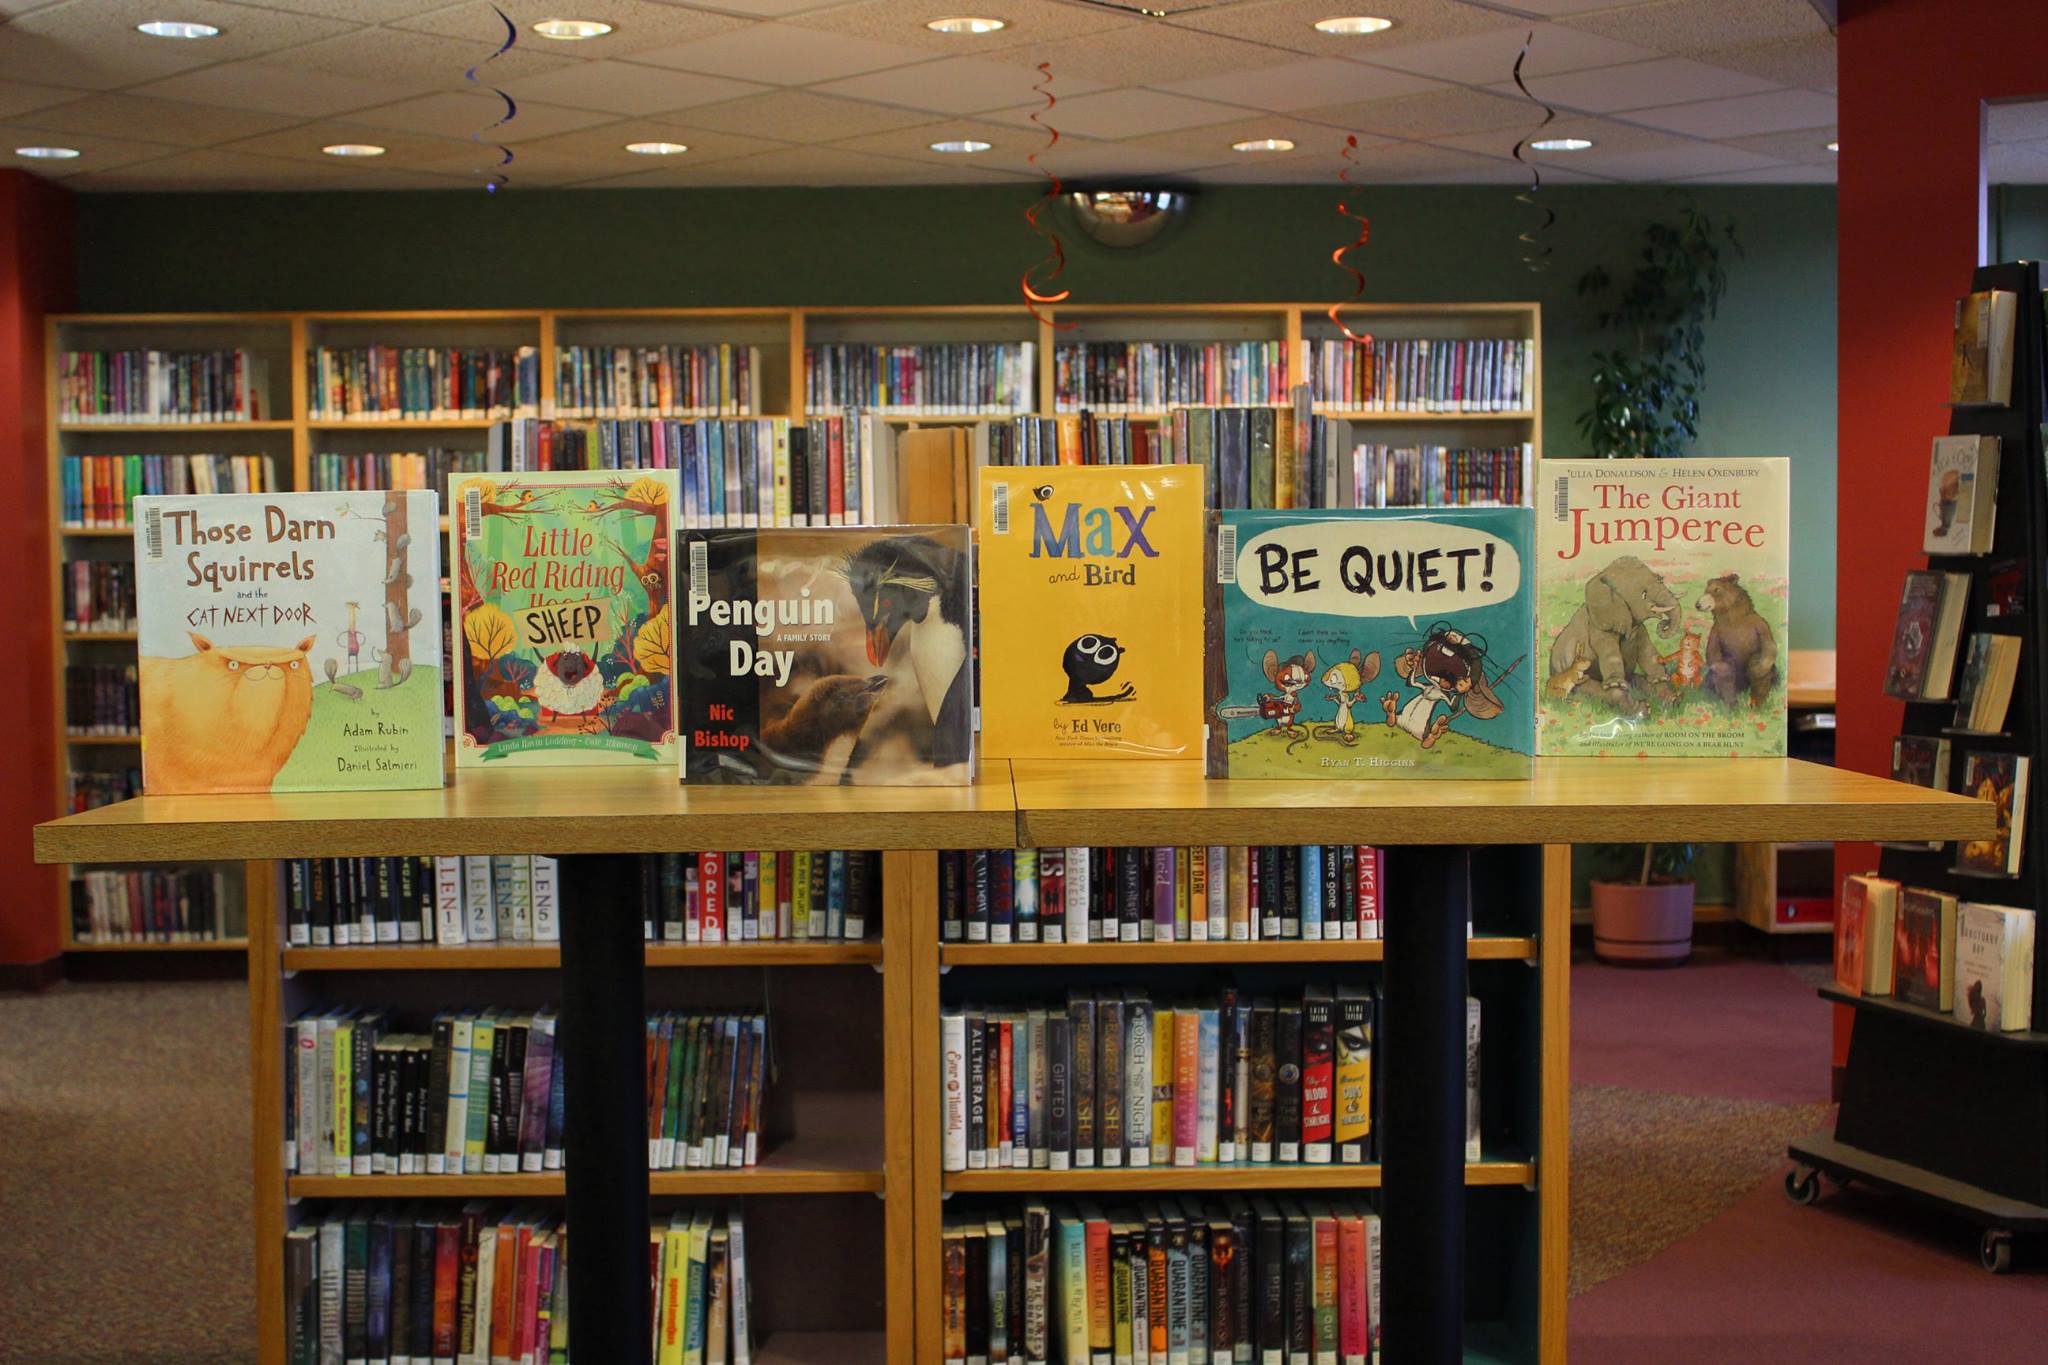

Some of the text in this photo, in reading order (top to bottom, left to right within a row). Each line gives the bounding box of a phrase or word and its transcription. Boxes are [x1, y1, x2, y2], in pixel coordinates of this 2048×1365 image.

[1568, 469, 1593, 479] ULIA
[1595, 469, 1656, 479] DONALDSON
[1672, 468, 1706, 478] HELEN
[1707, 468, 1760, 478] OXENBURY
[1593, 484, 1742, 511] The Giant
[162, 505, 336, 545] Those Darn
[523, 525, 593, 558] Little
[1557, 508, 1765, 559] Jumperee
[186, 551, 315, 592] Squirrels
[491, 561, 625, 593] Red Riding
[1049, 563, 1136, 587] and Bird
[1255, 543, 1496, 596] BE QUIET!
[237, 588, 268, 599] and the
[187, 602, 317, 628] CAT NEXT DOOR
[526, 604, 600, 644] SHEEP
[689, 587, 834, 636] Penguin
[784, 633, 807, 642] FAMILY
[809, 633, 831, 642] STORY
[730, 640, 795, 688] Day
[371, 708, 380, 718] by
[710, 704, 734, 721] Nic
[1053, 718, 1121, 735] by Ed Vere
[343, 722, 409, 737] Adam Rubin
[694, 731, 749, 752] Bishop
[337, 757, 417, 772] Daniel Salmieri
[1326, 852, 1336, 908] were gone
[1360, 854, 1376, 920] LIKE ME
[474, 907, 485, 920] 2
[501, 907, 510, 919] 3
[516, 908, 526, 920] 4
[538, 908, 549, 921] 5
[1133, 1016, 1145, 1065] TORCH
[971, 1086, 983, 1124] RAGE
[1053, 1064, 1064, 1117] GIFTED
[1133, 1095, 1144, 1143] NIGHT
[1117, 1270, 1129, 1324] QUARANTINE
[1134, 1265, 1145, 1319] QUARANTINE
[1151, 1260, 1165, 1330] QUARANTINE
[1172, 1260, 1186, 1330] QUARANTINE
[1192, 1255, 1206, 1324] QUARANTINE
[1323, 1314, 1333, 1340] OUT
